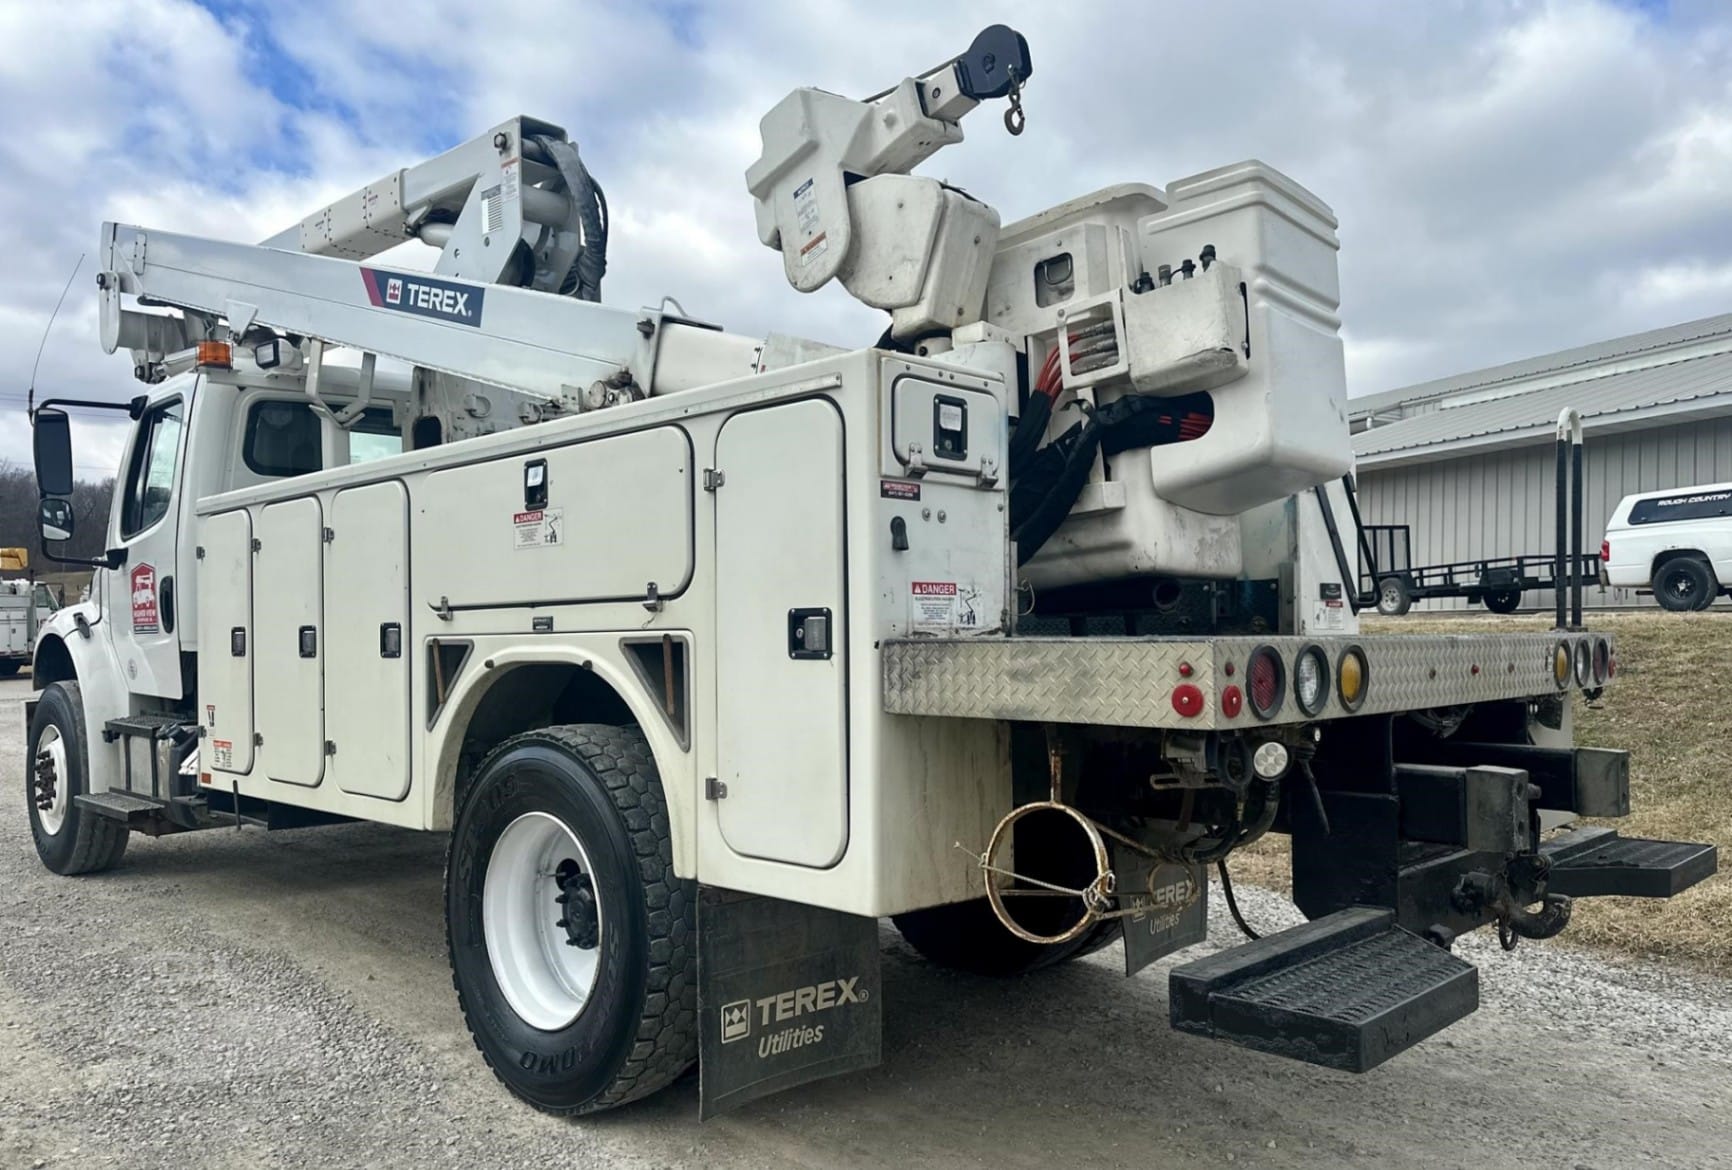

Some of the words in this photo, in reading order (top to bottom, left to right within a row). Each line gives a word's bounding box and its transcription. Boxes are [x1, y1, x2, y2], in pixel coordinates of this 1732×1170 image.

[407, 283, 469, 316] TEREX
[1657, 498, 1687, 506] ROUGH
[1688, 493, 1731, 503] COUNTRY
[519, 512, 542, 521] DANGER
[921, 584, 955, 594] DANGER
[1151, 879, 1194, 905] EREX
[756, 976, 859, 1026] TEREX
[758, 1025, 825, 1058] Utilities
